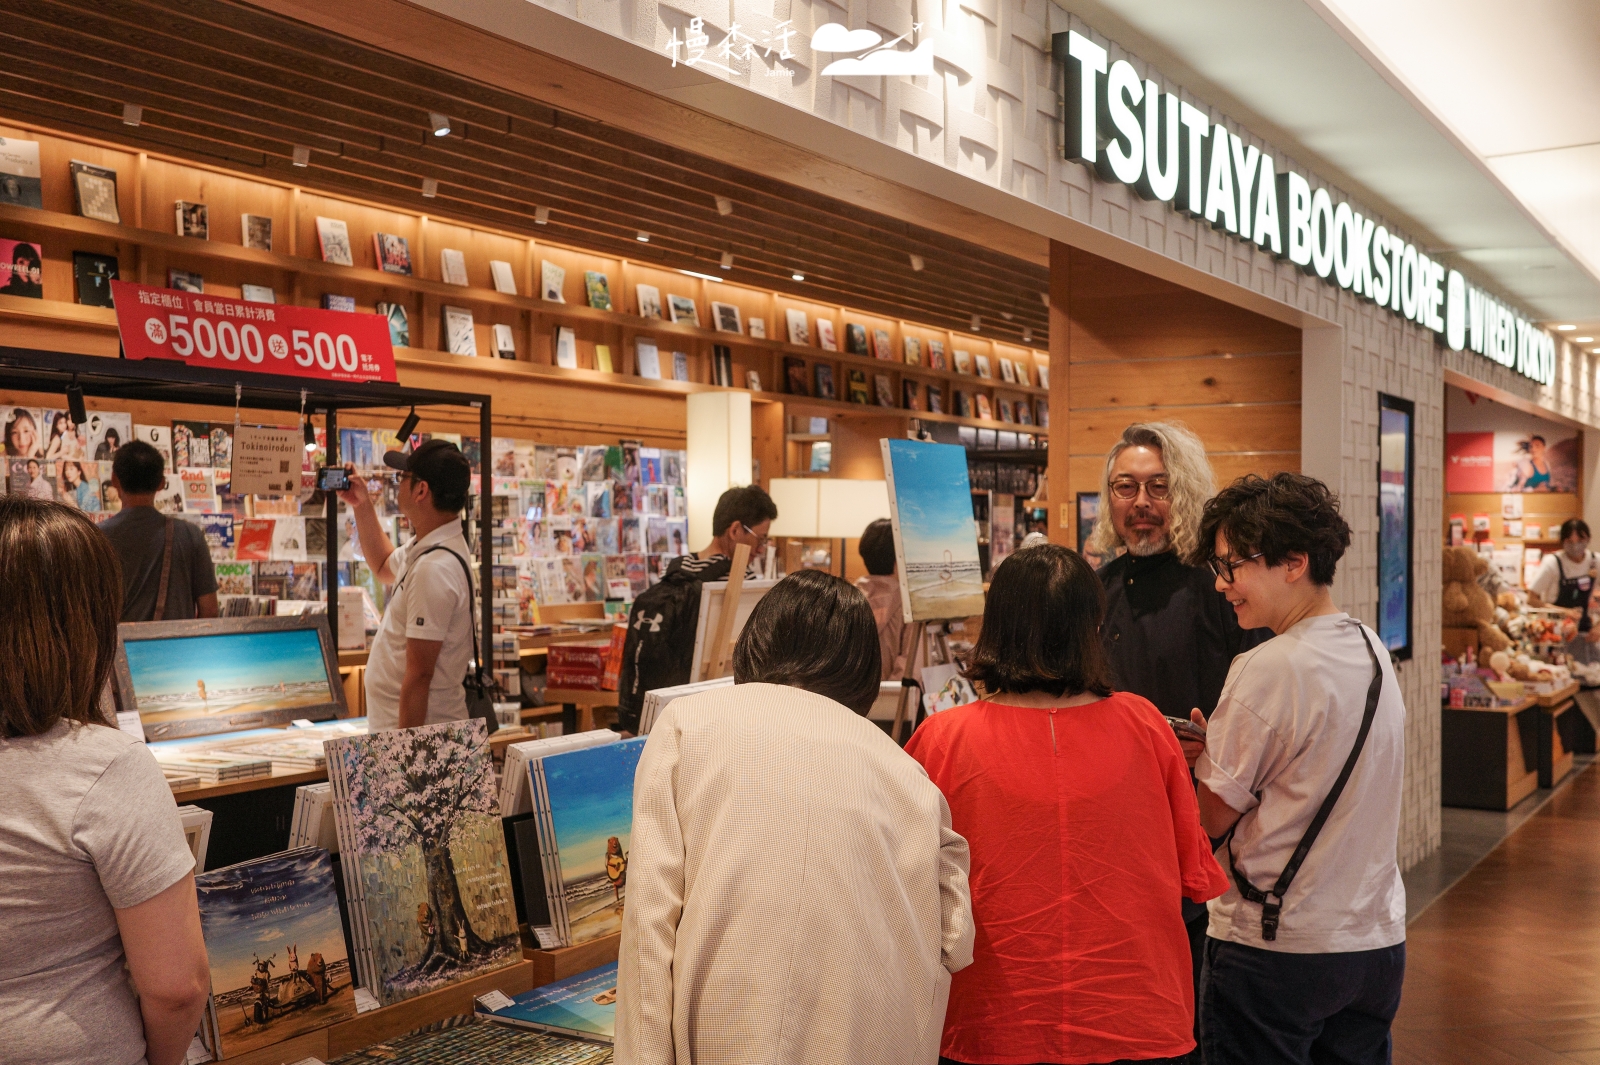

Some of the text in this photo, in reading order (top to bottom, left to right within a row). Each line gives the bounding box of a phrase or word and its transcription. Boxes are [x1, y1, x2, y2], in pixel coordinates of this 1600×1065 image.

[1067, 29, 1556, 388] TSUTAYA BOOKSTORE WIRED TOKYO
[138, 289, 276, 322] 指定櫃位 會員當日累計消費
[168, 313, 265, 364] 5000
[292, 329, 358, 373] 500
[241, 441, 296, 453] Tokinoirodori
[180, 469, 205, 482] 2nd
[246, 520, 269, 532] Begin
